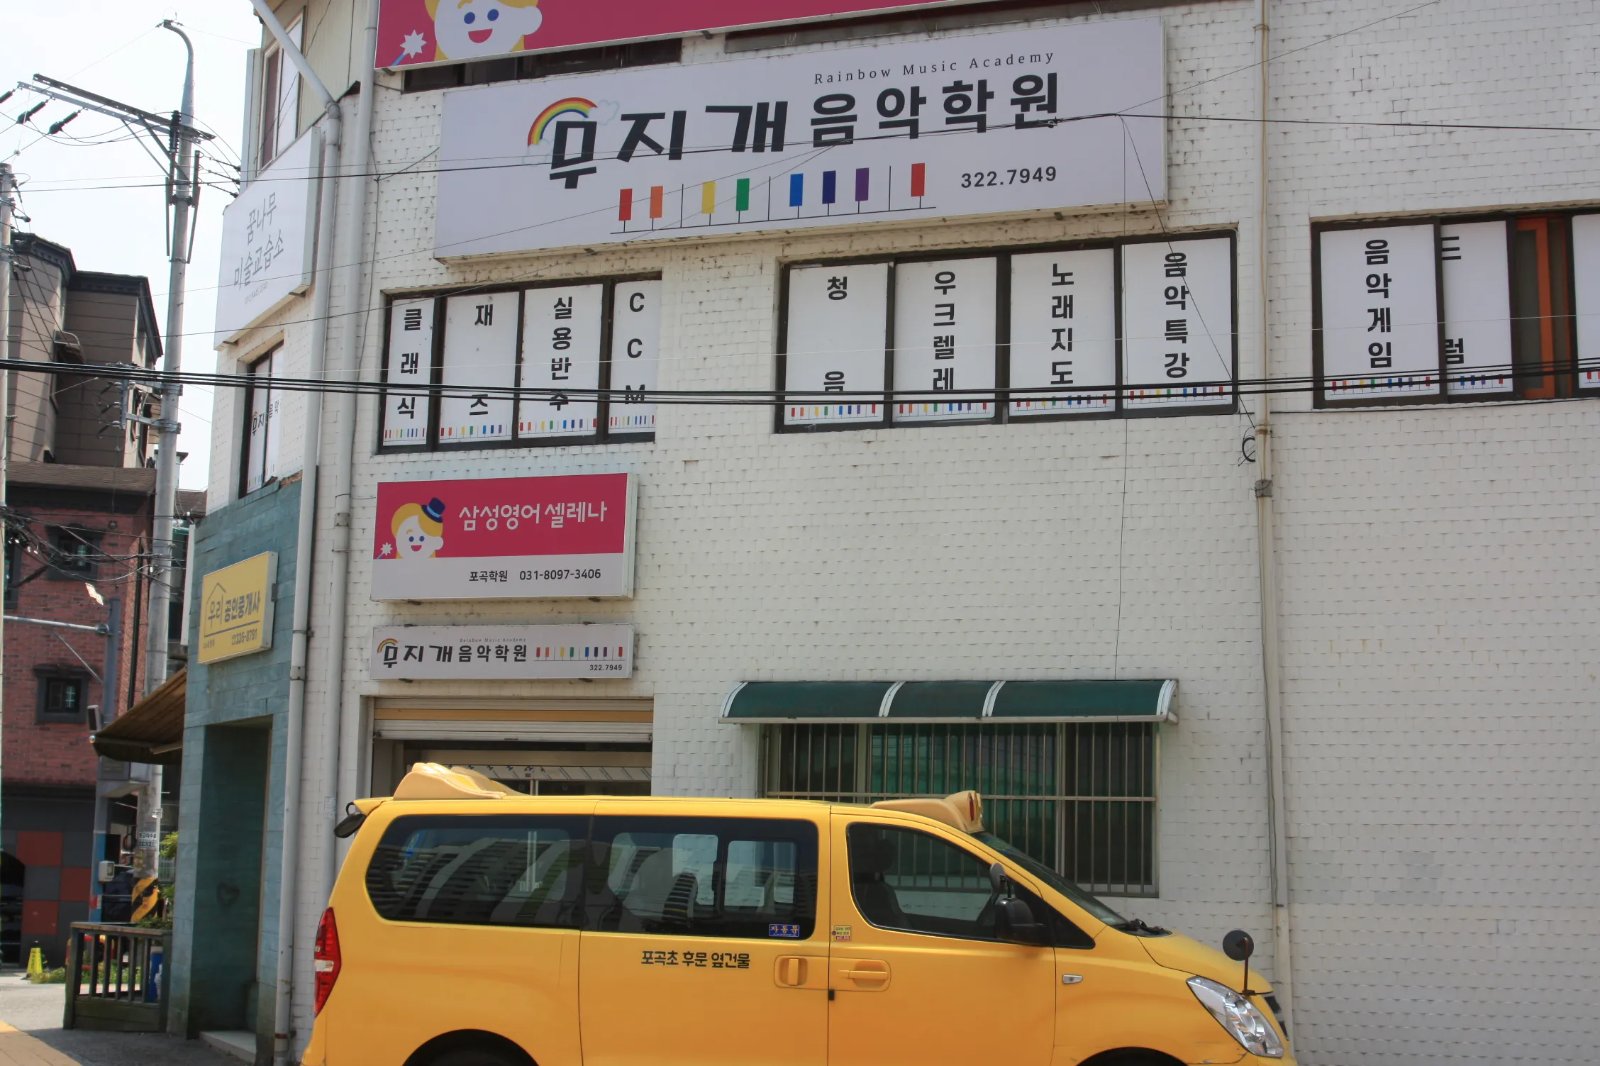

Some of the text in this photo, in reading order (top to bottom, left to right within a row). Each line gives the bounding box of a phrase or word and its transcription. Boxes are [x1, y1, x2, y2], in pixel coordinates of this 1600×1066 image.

[814, 52, 1055, 85] Rainbow Music Academy
[960, 165, 1058, 189] 322.7949
[932, 270, 957, 392] 우크렐레
[1049, 262, 1075, 386] 노래지도
[1162, 251, 1190, 379] 음악특강
[1364, 238, 1393, 369] 음악게임
[396, 307, 423, 420] 클래식
[548, 295, 574, 412] 실용반주
[458, 500, 608, 532] 삼성영어 셀레나
[468, 568, 602, 583] 포곡학원 031-8097-3406
[589, 664, 623, 672] 322.7949
[641, 950, 751, 969] 포곡초 후문 옆건물
